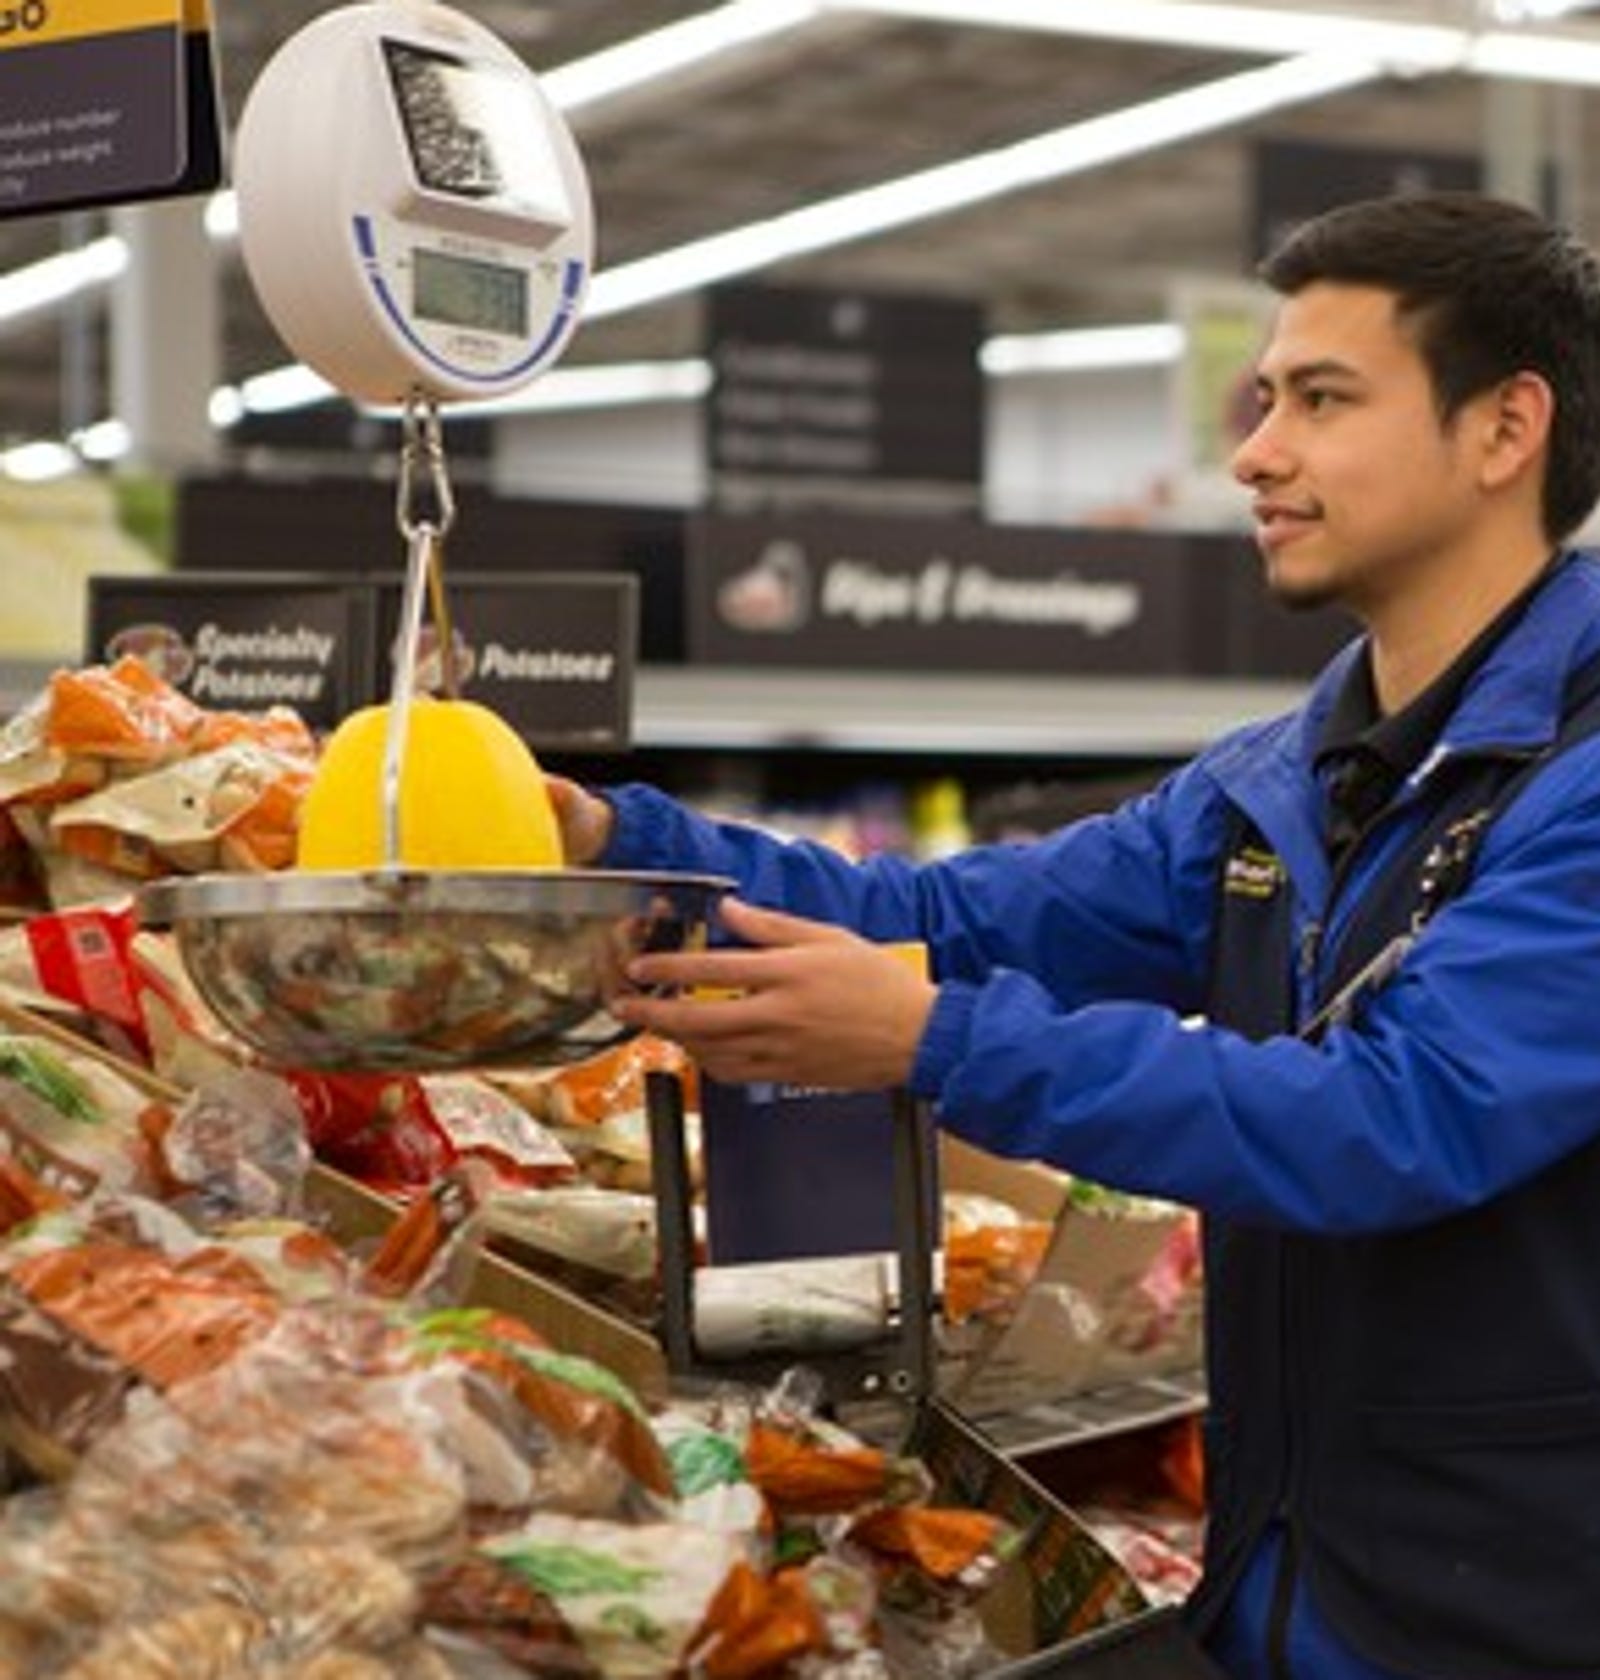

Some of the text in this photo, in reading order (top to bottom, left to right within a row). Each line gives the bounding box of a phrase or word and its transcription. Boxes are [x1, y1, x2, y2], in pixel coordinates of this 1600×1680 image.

[196, 621, 336, 669] Specialty
[479, 643, 615, 681] Potatoes
[192, 664, 324, 700] Potatoes
